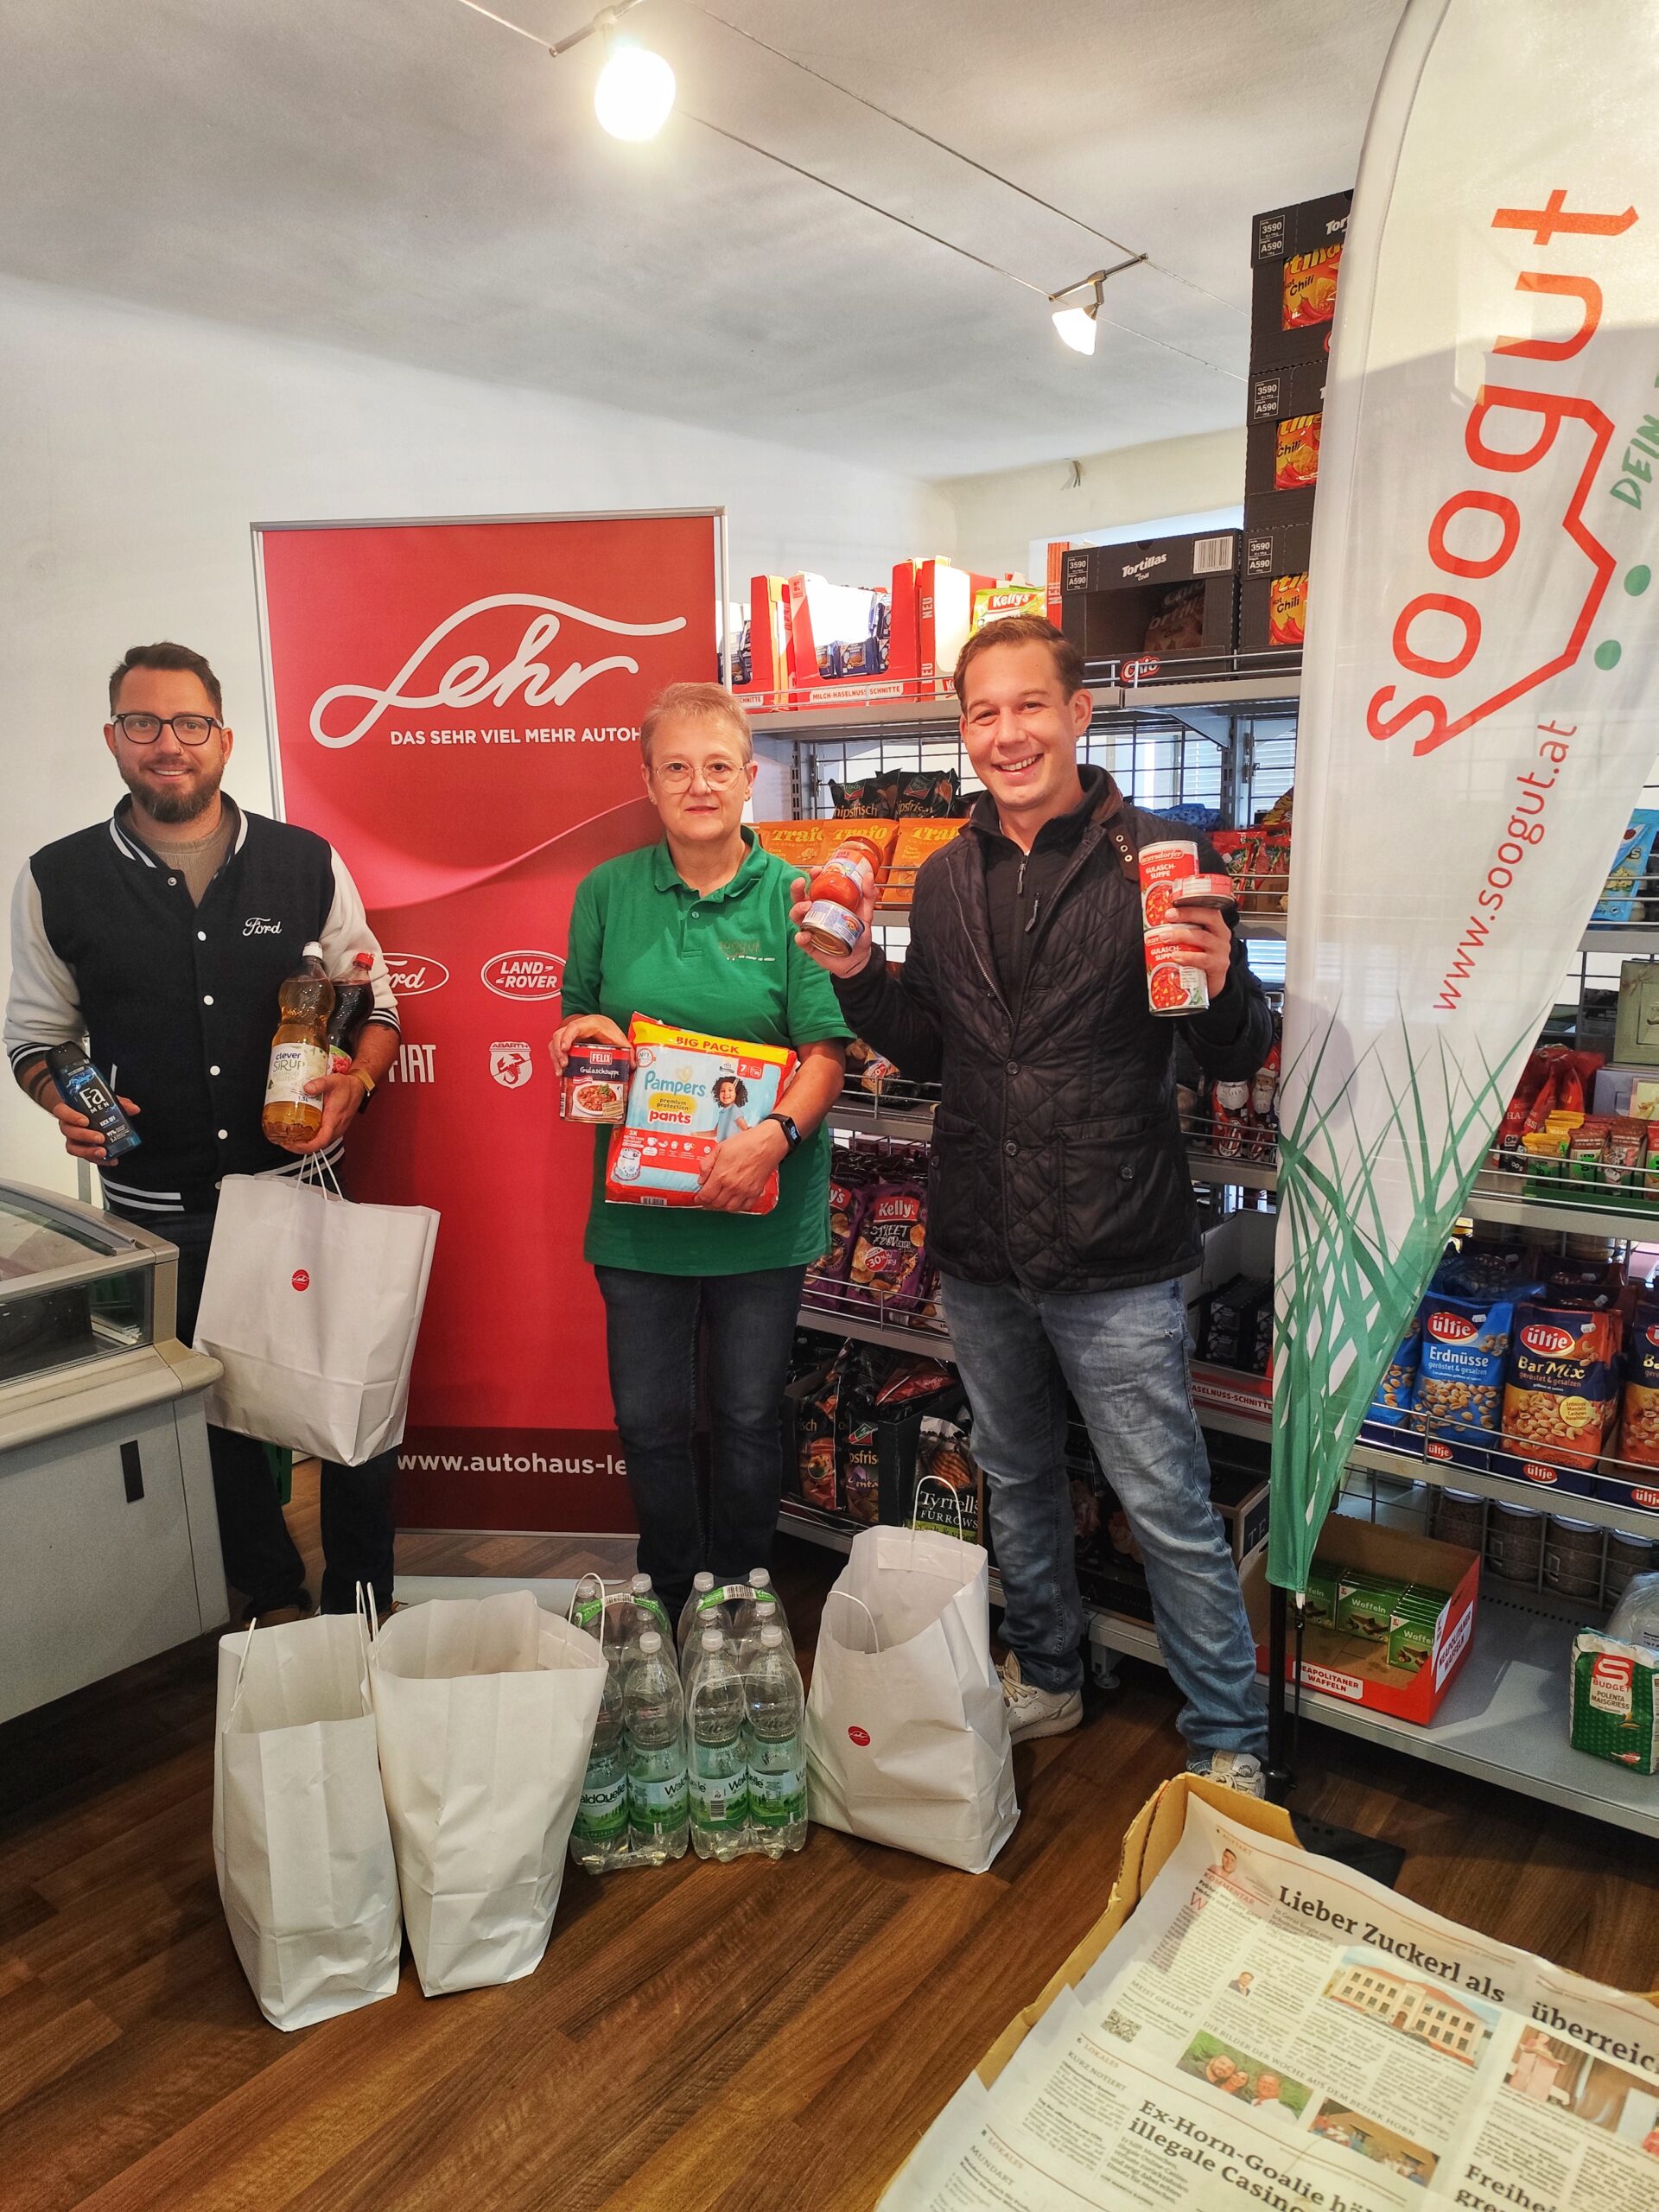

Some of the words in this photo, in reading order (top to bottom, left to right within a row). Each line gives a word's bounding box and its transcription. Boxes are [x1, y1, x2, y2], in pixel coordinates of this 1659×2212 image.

[1262, 221, 1282, 234] 3590
[1325, 217, 1348, 235] Tor
[1261, 240, 1282, 253] A590
[1290, 275, 1314, 297] Chili
[1257, 384, 1277, 396] 3590
[1255, 402, 1277, 414] A590
[1367, 189, 1639, 756] soogut
[1250, 542, 1270, 552] 3590
[1069, 560, 1087, 569] 3590
[1122, 553, 1167, 578] Tortillas
[1249, 559, 1270, 569] A590
[1068, 577, 1086, 586] A590
[922, 596, 933, 620] NEU
[1277, 595, 1300, 613] Chili
[309, 593, 687, 749] Lehr
[391, 730, 428, 746] DAS
[430, 729, 477, 745] SEHR
[480, 728, 521, 744] VIEL
[525, 728, 576, 743] MEHR
[1433, 720, 1577, 1010] www.soogut.at
[1150, 870, 1170, 880] SUPPE
[243, 917, 282, 937] Ford
[500, 962, 543, 974] LAND
[505, 976, 557, 988] ROVER
[676, 1036, 698, 1047] BIG
[702, 1040, 740, 1054] PACK
[592, 1053, 611, 1063] FELIX
[645, 1071, 706, 1097] Pampers
[79, 1087, 105, 1109] Fa
[90, 1102, 110, 1114] MEN
[649, 1109, 691, 1124] pants
[1433, 1316, 1471, 1338] ültje
[1527, 1327, 1568, 1350] ültje
[1429, 1346, 1489, 1367] Erdnüsse
[1518, 1356, 1544, 1372] Bar
[1545, 1361, 1586, 1379] Mix
[1428, 1445, 1450, 1457] ültje
[397, 1452, 627, 1475] www.autohaus-le
[1527, 1465, 1553, 1479] ültje
[919, 1491, 978, 1515] Tyrrells
[920, 1510, 978, 1529] FURROWS
[1351, 1598, 1386, 1614] Waffeln
[1307, 1675, 1346, 1692] WAFFELN
[1592, 1678, 1630, 1694] BUDGET
[1592, 1694, 1630, 1710] MAISGRIESS
[1597, 1690, 1625, 1702] POLENTA
[1204, 1872, 1254, 1905] KOMMENTAR
[1278, 1885, 1358, 1935] Lieber
[1362, 1923, 1461, 1983] Zuckerl
[1465, 1976, 1505, 2003] als
[1068, 2050, 1090, 2070] KURZ
[1090, 2068, 1128, 2091] NOTIERT
[1219, 2029, 1250, 2053] BILDER
[1252, 2046, 1270, 2062] DER
[1272, 2056, 1306, 2080] WOCHE
[1306, 2075, 1326, 2090] AUS
[1326, 2086, 1350, 2102] DEM
[1385, 2116, 1416, 2137] HORN
[1128, 2117, 1217, 2173] illegale
[1138, 2100, 1325, 2205] Ex-Horn-Goalie
[969, 2145, 1015, 2187] MUNDART
